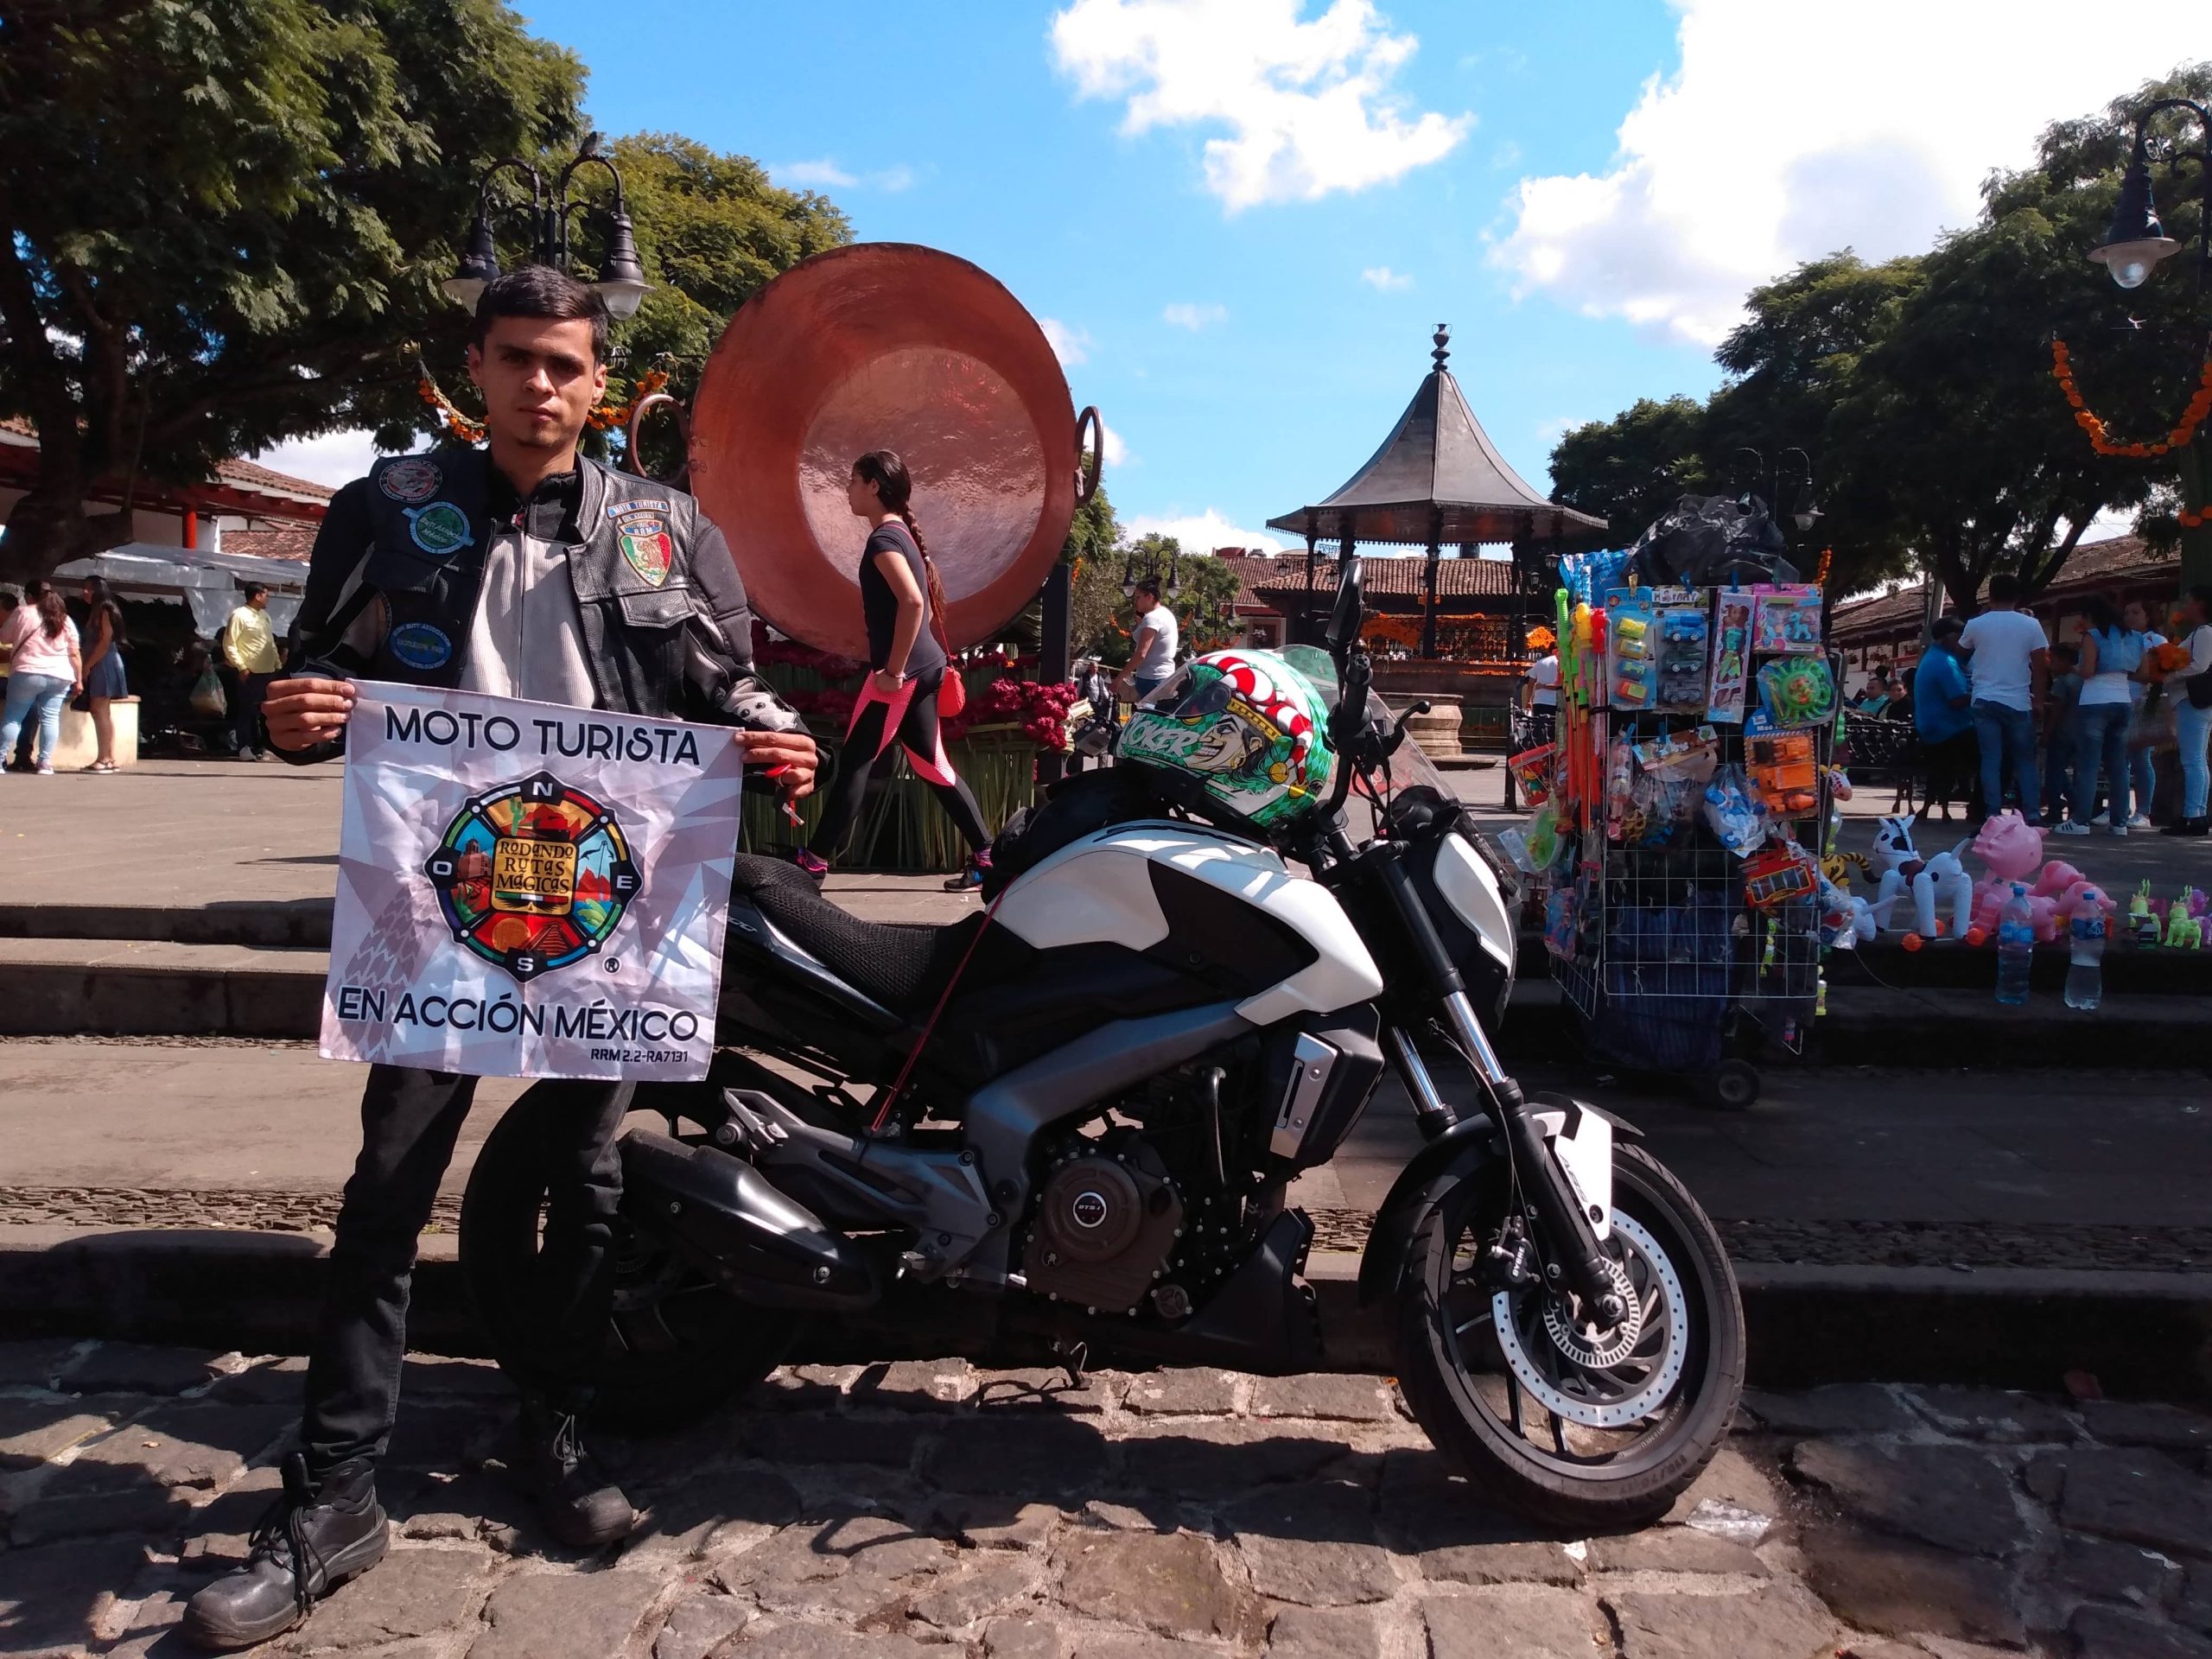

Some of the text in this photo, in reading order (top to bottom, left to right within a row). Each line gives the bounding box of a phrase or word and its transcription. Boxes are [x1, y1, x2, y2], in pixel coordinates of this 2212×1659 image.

[613, 500, 663, 515] MOTO TURISTA
[385, 705, 701, 766] MOTO TURISTA
[532, 781, 554, 797] N
[616, 875, 632, 889] E
[727, 915, 758, 932] 00
[517, 957, 534, 971] S
[338, 987, 698, 1040] EN ACCIÓN MÉXICO
[590, 1047, 689, 1064] RRM 2.2-RA7131
[1512, 1245, 1526, 1277] BYBRE
